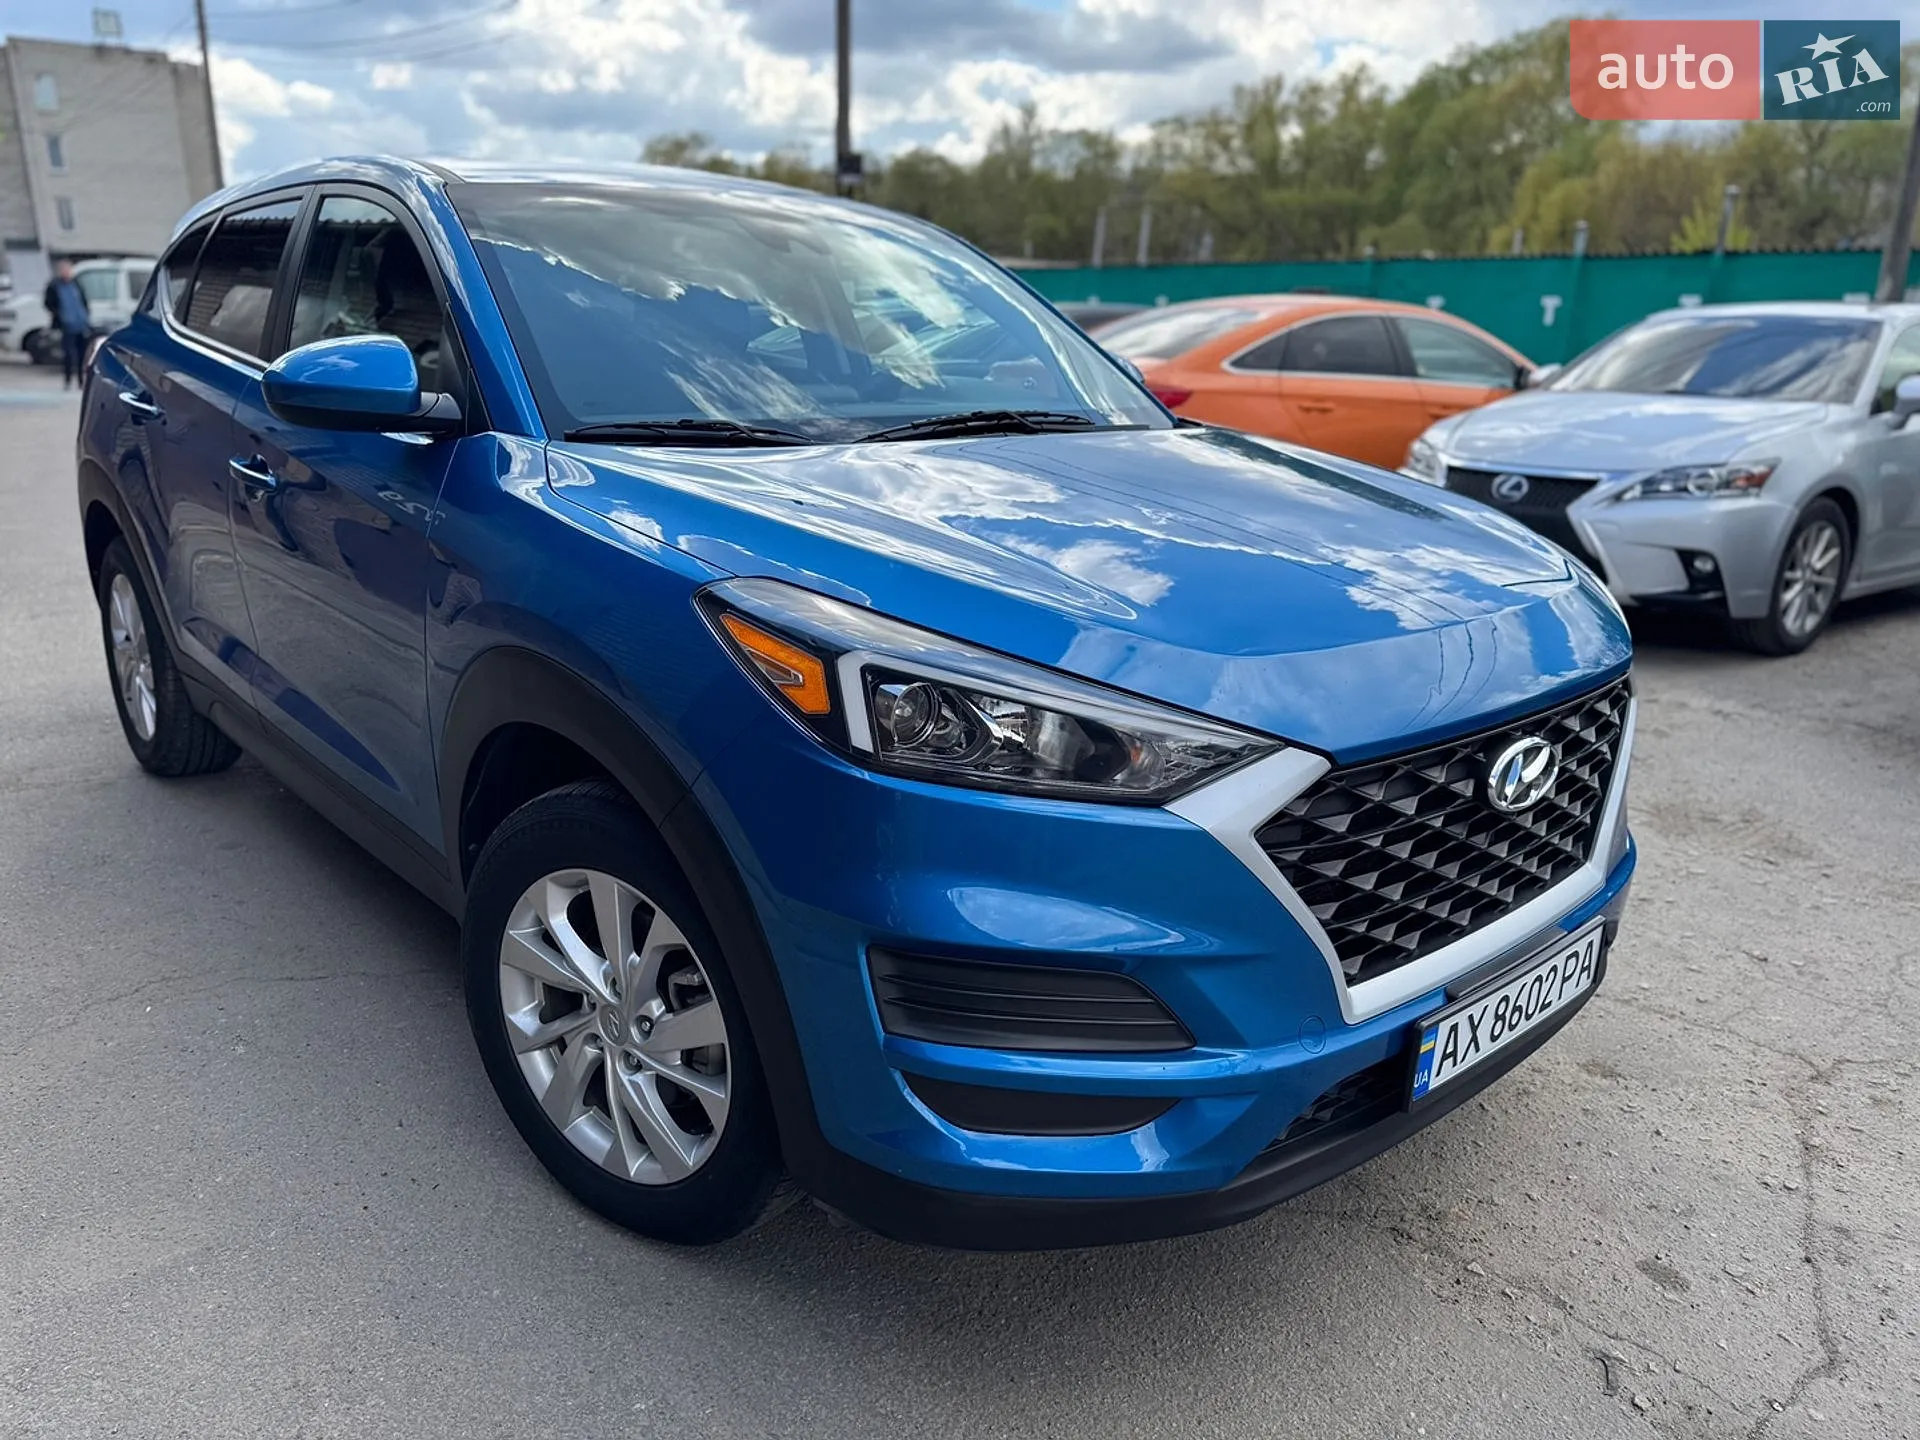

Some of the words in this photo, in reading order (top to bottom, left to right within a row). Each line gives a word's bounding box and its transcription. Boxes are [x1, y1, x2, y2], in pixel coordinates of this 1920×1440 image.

[1435, 1004, 1489, 1078] AX
[1490, 963, 1558, 1043] 8602
[1558, 938, 1594, 1001] PA
[1413, 1069, 1428, 1088] UA
